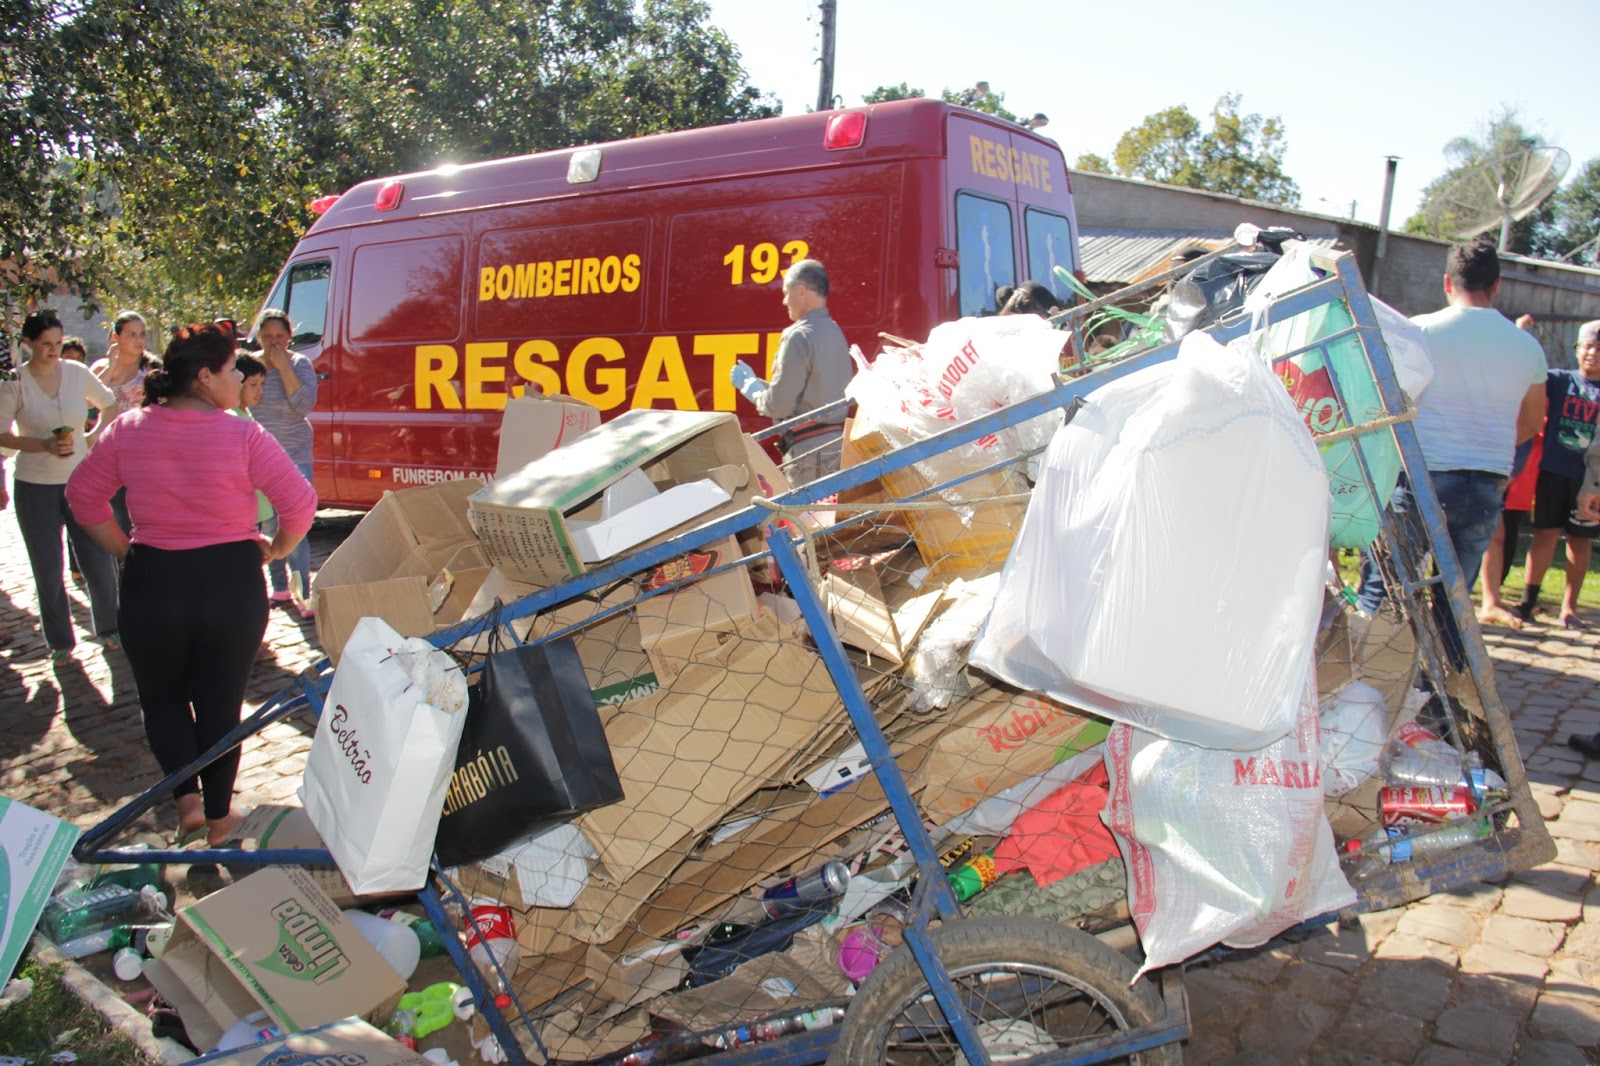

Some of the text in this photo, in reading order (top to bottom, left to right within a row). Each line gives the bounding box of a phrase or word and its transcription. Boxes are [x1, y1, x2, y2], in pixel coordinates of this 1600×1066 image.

[969, 135, 1053, 192] RESGATE
[479, 254, 641, 301] BOMBEIROS
[392, 467, 464, 485] FUNREBOM
[519, 532, 531, 559] PINHO
[521, 516, 548, 579] DESINFETANTE
[533, 533, 545, 558] ROSA
[543, 519, 566, 569] AMACIANTE
[330, 704, 373, 785] Beltrão
[442, 745, 519, 816] ARABÓIA
[24, 823, 50, 866] Resistência
[270, 897, 351, 986] Limpa
